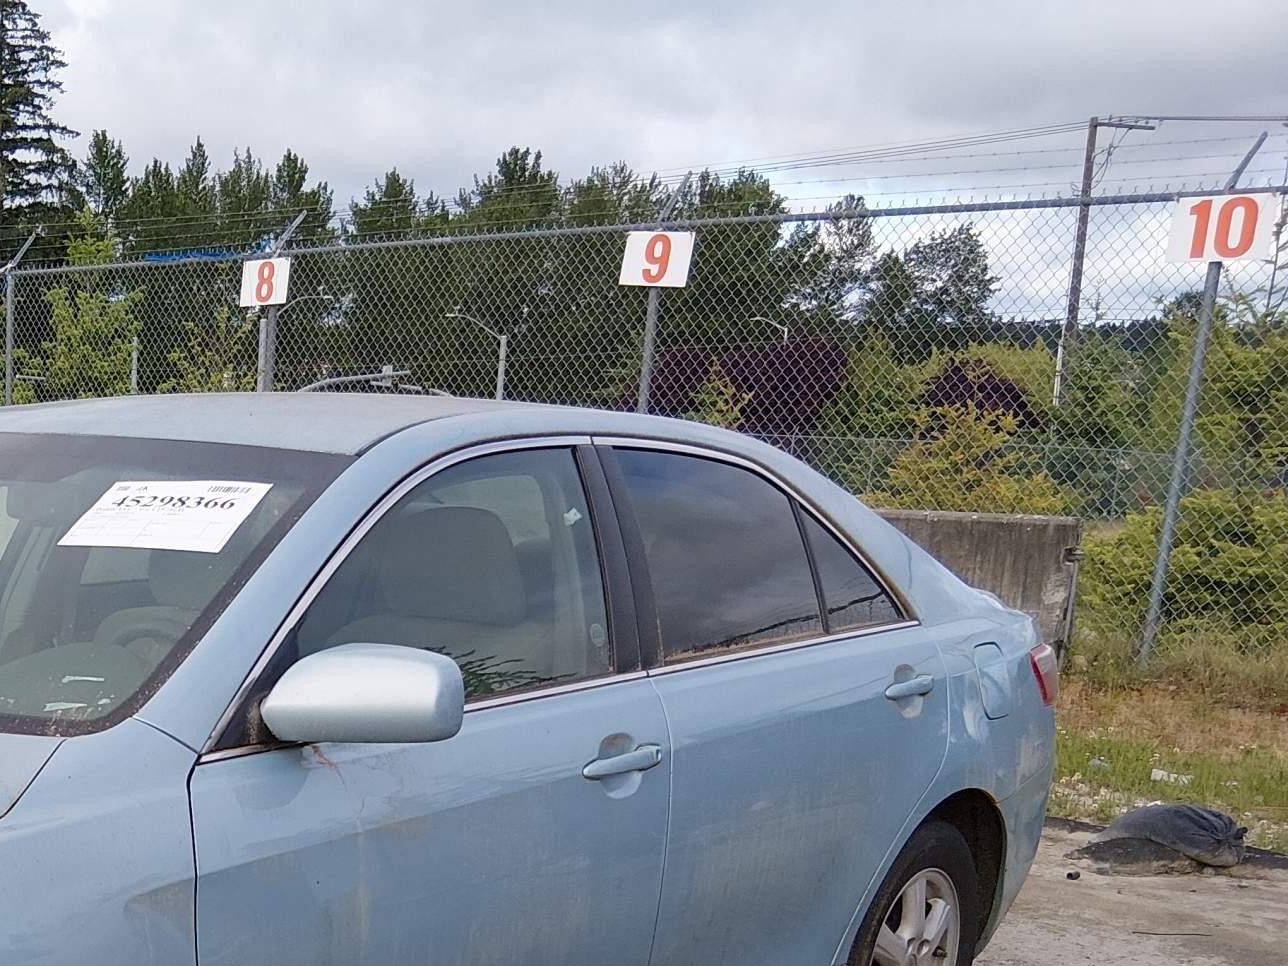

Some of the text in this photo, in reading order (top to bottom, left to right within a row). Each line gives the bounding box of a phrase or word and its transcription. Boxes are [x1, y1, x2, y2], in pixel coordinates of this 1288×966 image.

[1190, 195, 1261, 258] 10
[255, 260, 276, 303] 8
[642, 233, 672, 284] 9
[112, 495, 240, 510] 45298366
